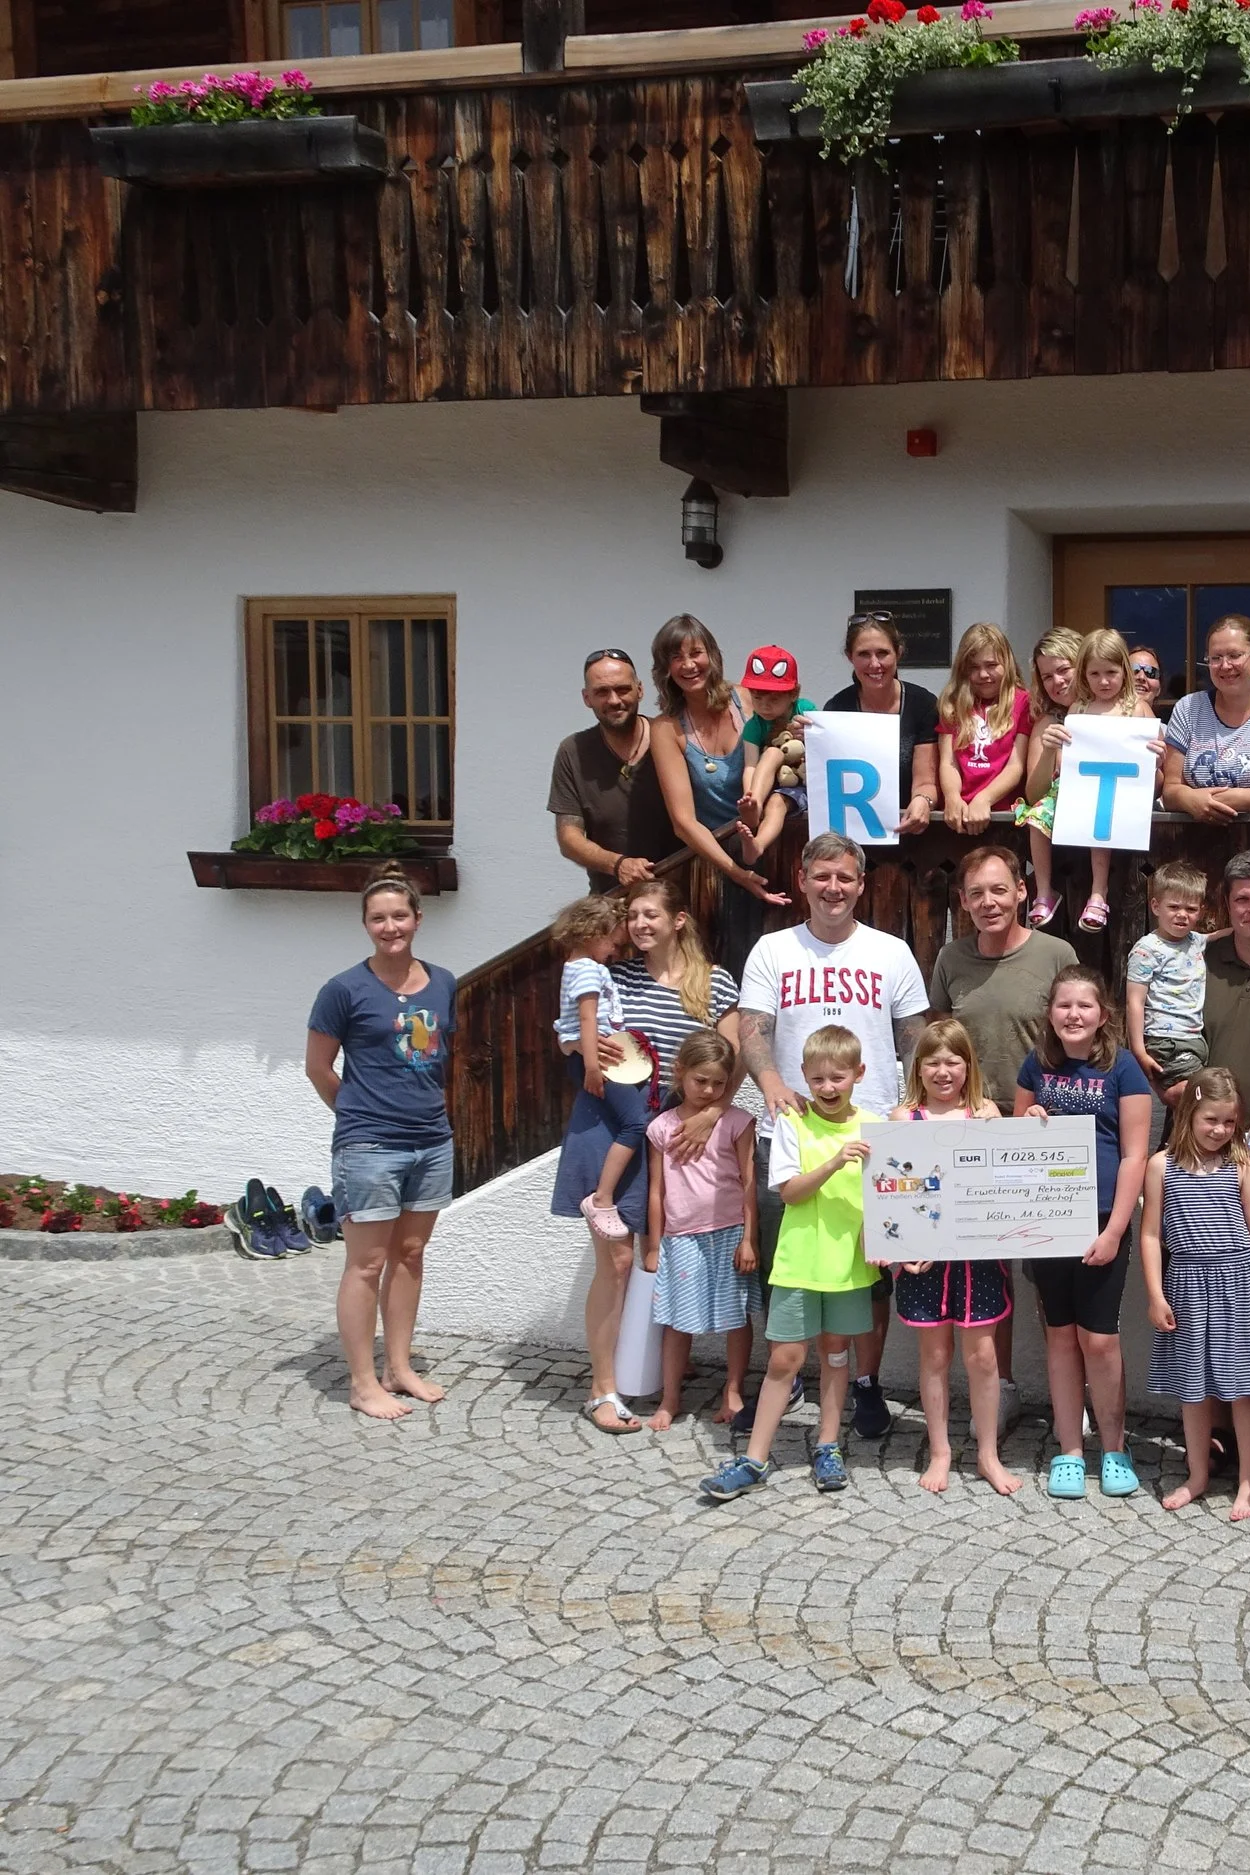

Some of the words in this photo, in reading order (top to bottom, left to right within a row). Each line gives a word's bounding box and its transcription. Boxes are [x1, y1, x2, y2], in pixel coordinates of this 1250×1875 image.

[825, 757, 888, 839] R
[1078, 760, 1140, 842] T
[780, 966, 882, 1010] ELLESSE
[1042, 1073, 1105, 1096] YEAH
[966, 1186, 1031, 1198] Erweiterung
